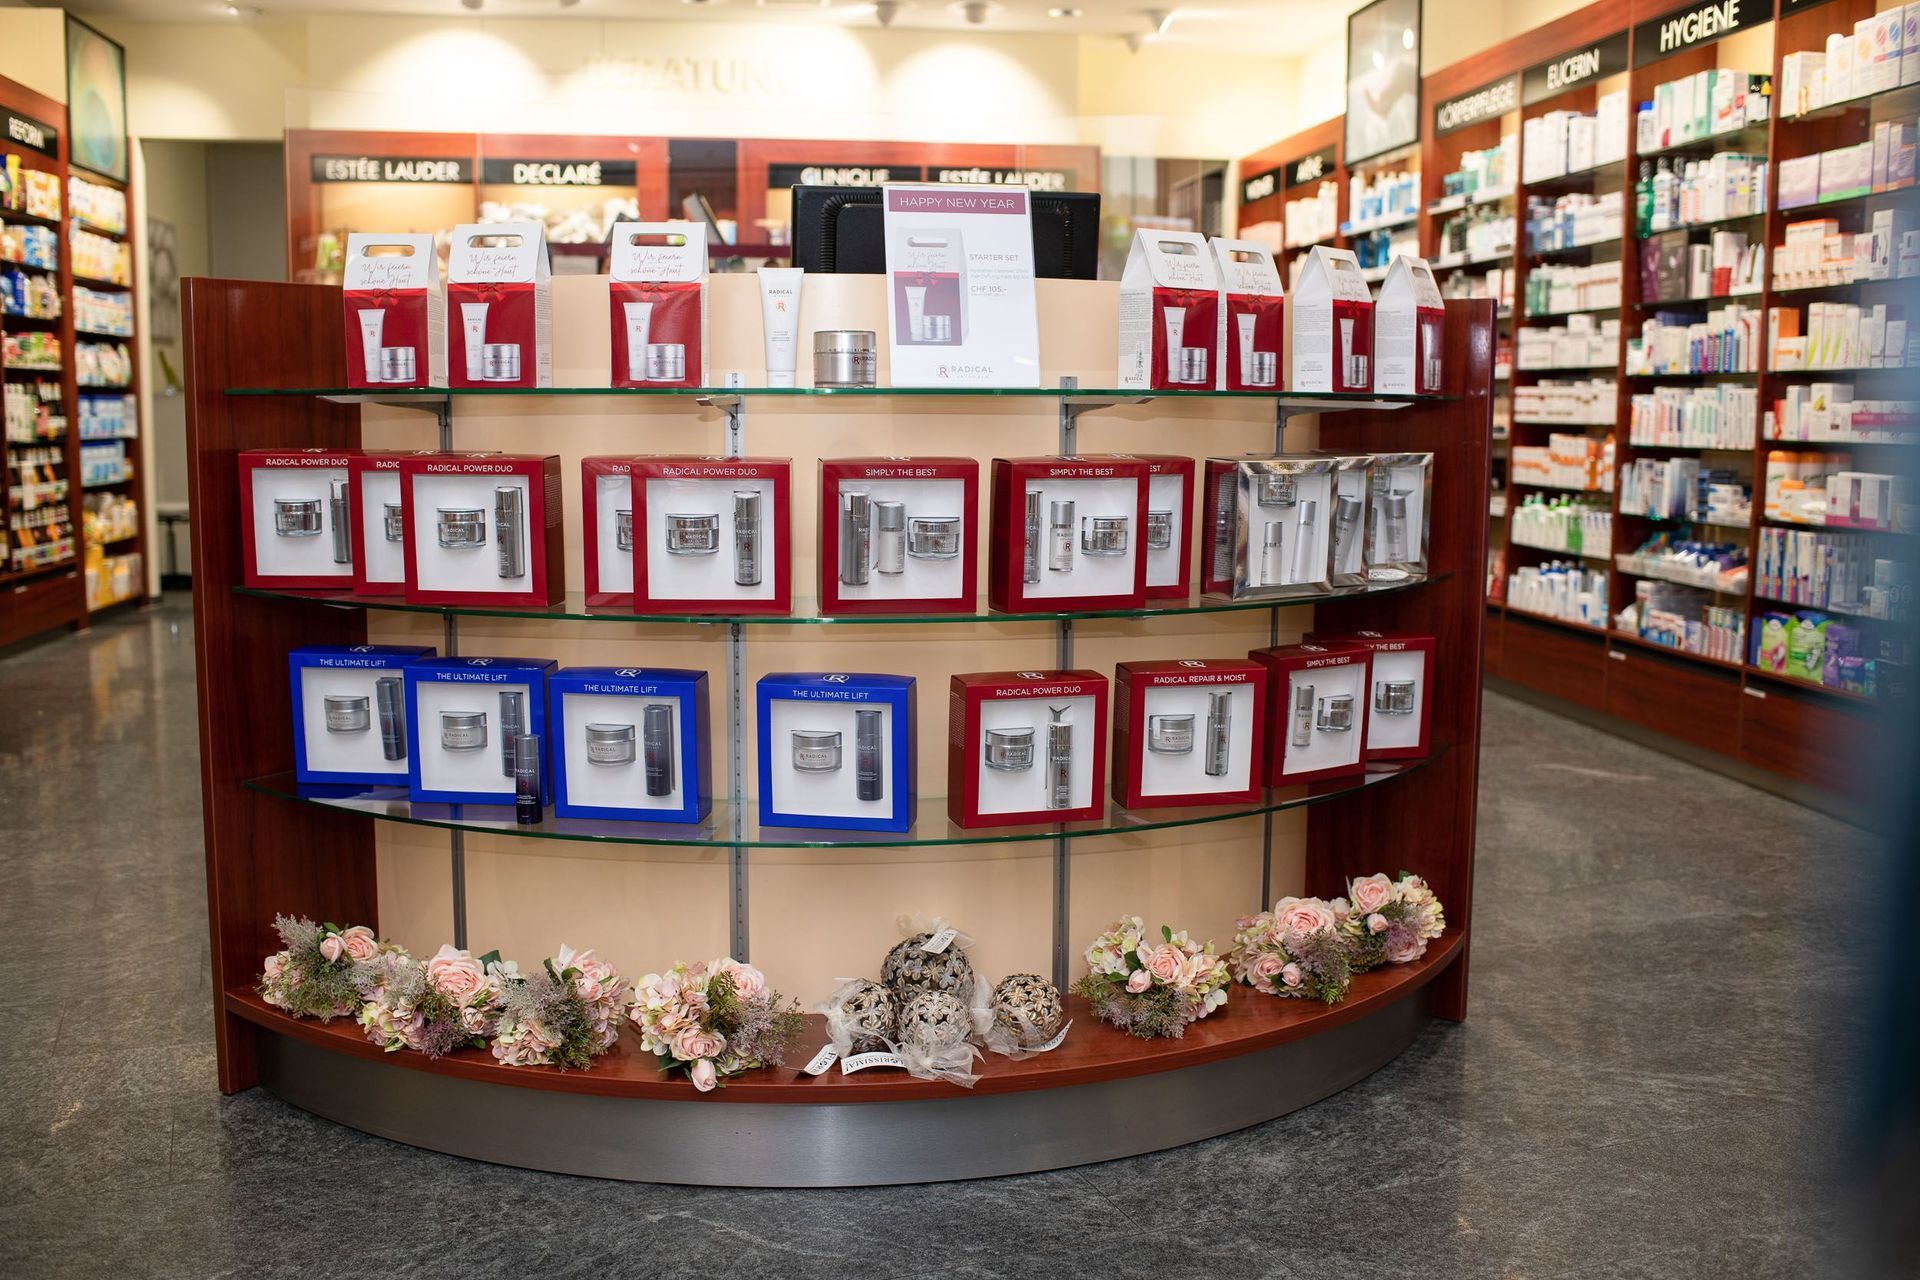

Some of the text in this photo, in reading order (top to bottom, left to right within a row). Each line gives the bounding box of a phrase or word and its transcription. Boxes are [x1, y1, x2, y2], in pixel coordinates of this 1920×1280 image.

[1660, 0, 1740, 52] HYGIENE
[1547, 48, 1600, 90] EUCERIN
[325, 156, 460, 182] ESTÉE LAUDER
[513, 161, 602, 185] DECLARÉ
[900, 197, 1015, 209] HAPPY NEW YEAR
[970, 285, 987, 293] CHF
[266, 458, 348, 466] RADICAL POWER DUO
[427, 464, 513, 473] RADICAL POWER DUO
[738, 468, 757, 476] DUO
[865, 469, 895, 477] SIMPLY
[915, 468, 937, 476] BEST
[1050, 468, 1077, 476] SIMPLY
[335, 659, 370, 667] ULTIMATE
[1306, 659, 1325, 668] SIMPLY
[1337, 656, 1350, 664] BEST
[453, 673, 490, 681] ULTIMATE
[1154, 676, 1188, 684] RADICAL
[1189, 675, 1216, 683] REPAIR
[584, 684, 658, 694] THE ULTIMATE LIFT
[996, 686, 1081, 697] RADICAL POWER DUO
[810, 690, 850, 699] ULTIMATE
[851, 692, 869, 700] LIFT
[846, 1056, 904, 1071] LORISSIMA!
